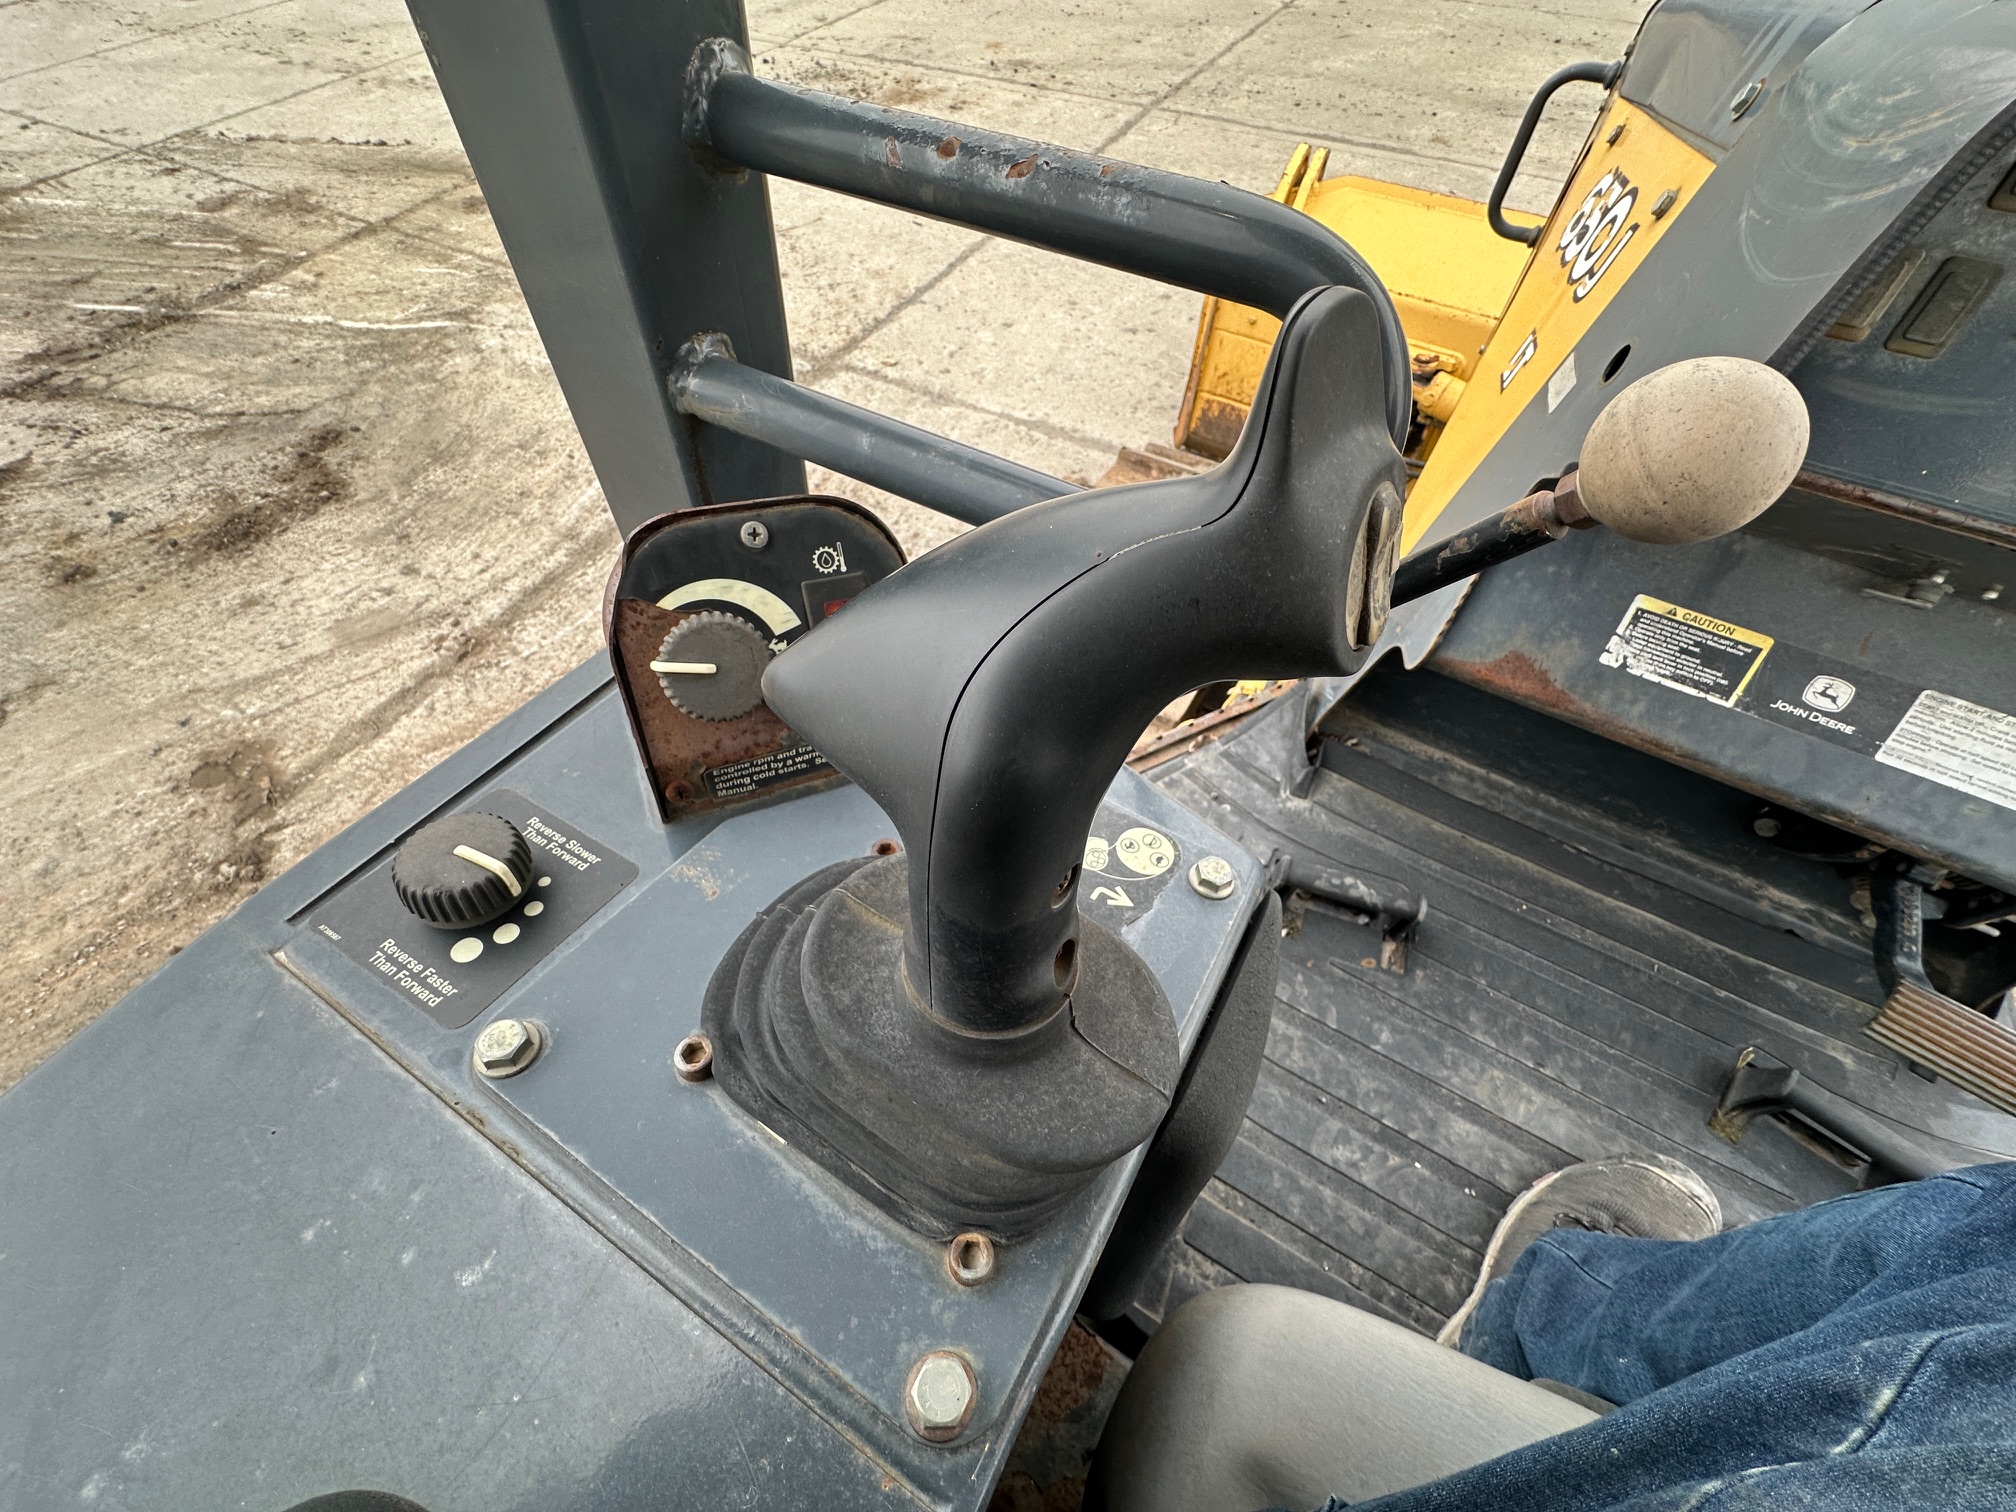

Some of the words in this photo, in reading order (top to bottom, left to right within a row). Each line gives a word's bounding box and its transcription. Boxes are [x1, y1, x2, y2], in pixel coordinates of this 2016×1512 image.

[1660, 619, 1679, 628] DEATH
[1682, 612, 1736, 636] CAUTION
[1769, 699, 1809, 718] JOHN
[1808, 711, 1856, 735] DEERE
[1924, 694, 1957, 708] ENGINE
[1956, 704, 1985, 717] START
[1985, 714, 2005, 724] AND
[713, 762, 750, 776] Engine
[753, 756, 774, 765] rpm
[777, 749, 796, 759] and
[715, 763, 768, 783] controlled
[771, 761, 784, 769] by
[715, 776, 751, 790] during
[753, 770, 776, 781] cold
[778, 763, 810, 774] starts.
[717, 783, 759, 797] Manual.
[522, 826, 548, 847] Than
[545, 841, 591, 871] Forward
[526, 816, 567, 844] Reverse
[565, 839, 602, 864] Slower
[368, 950, 398, 977] Than
[393, 969, 444, 1008] Forward
[379, 938, 424, 973] Reverse
[420, 967, 459, 997] Faster
